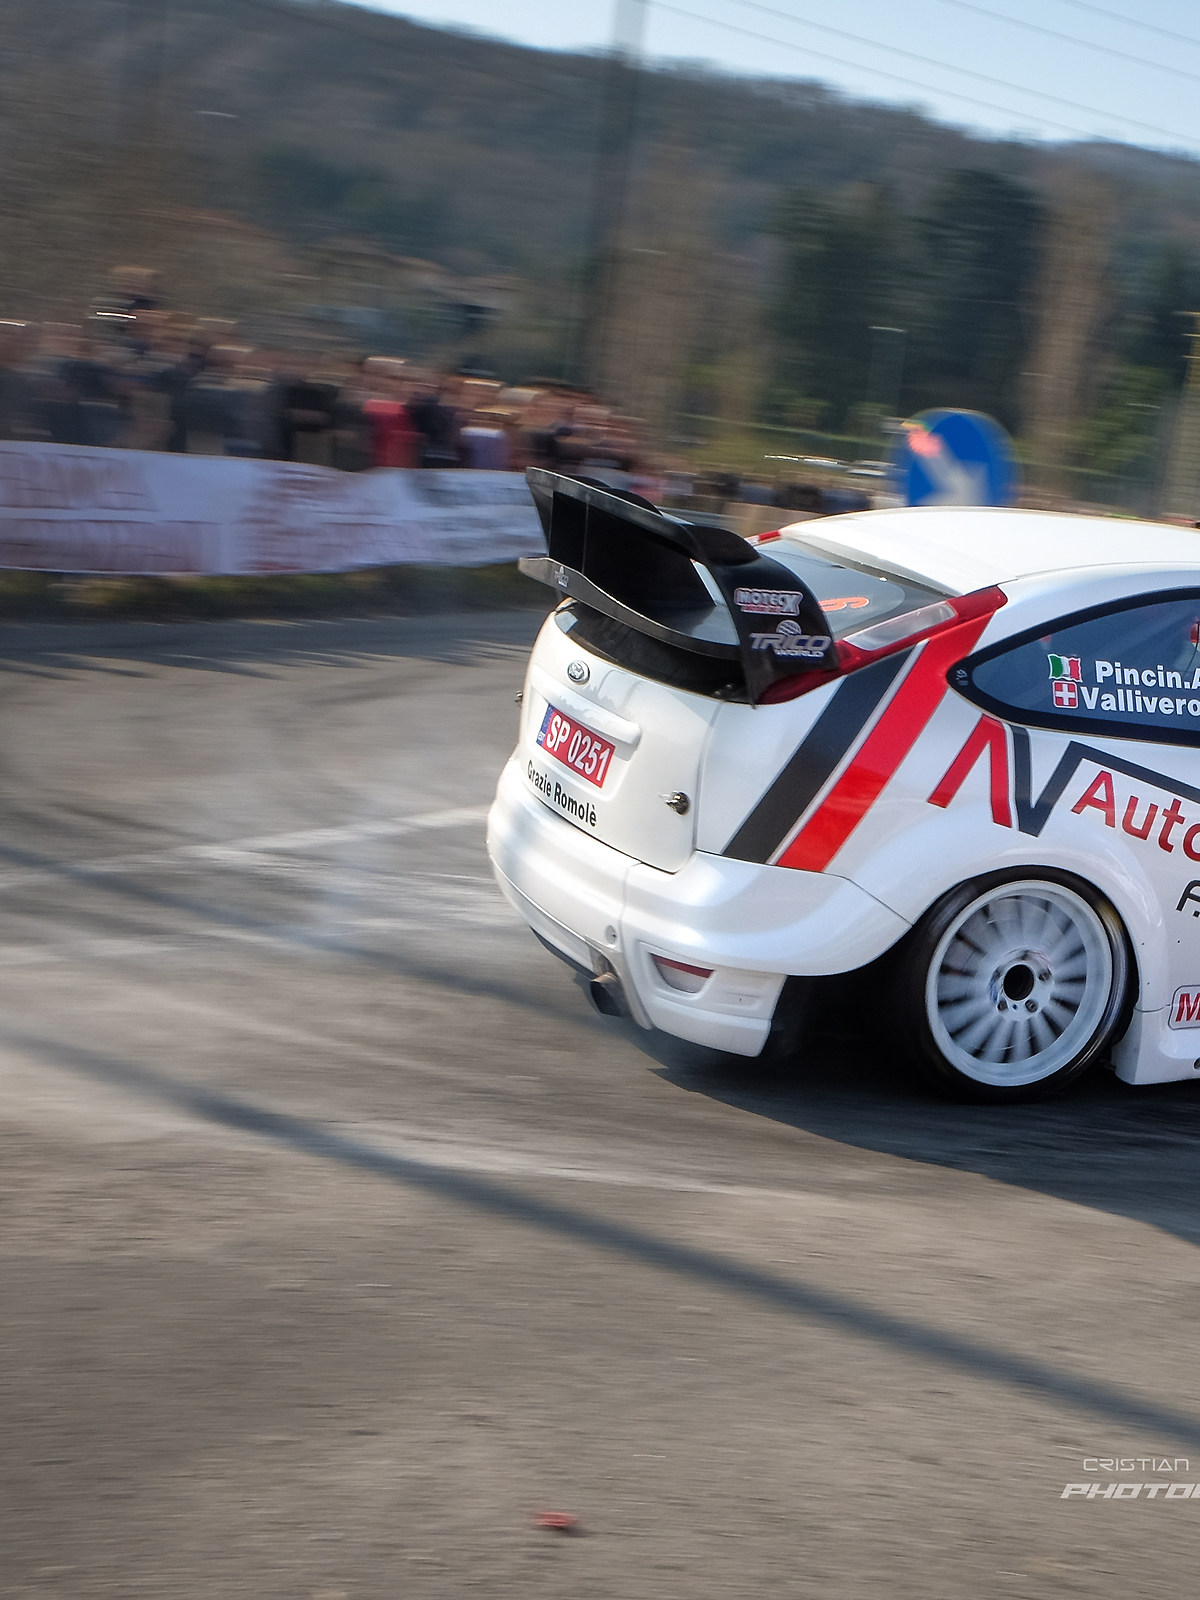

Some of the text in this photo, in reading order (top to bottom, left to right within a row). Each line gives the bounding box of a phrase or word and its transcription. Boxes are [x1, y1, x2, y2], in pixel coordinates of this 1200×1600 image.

[748, 632, 832, 653] TRICO
[775, 649, 825, 658] WORLD
[546, 714, 611, 782] SP 0251
[527, 759, 598, 828] Grazie Romolè
